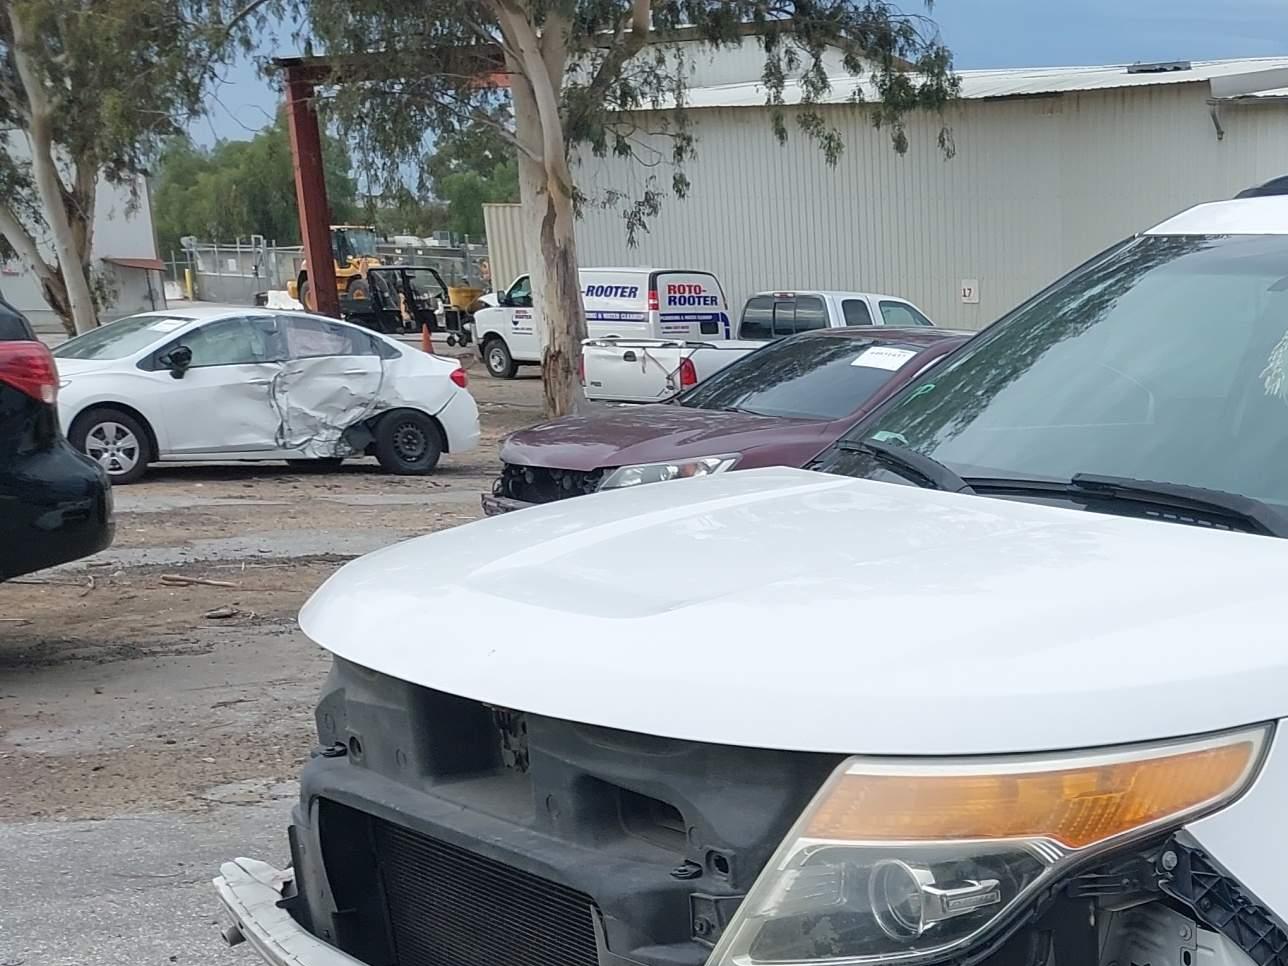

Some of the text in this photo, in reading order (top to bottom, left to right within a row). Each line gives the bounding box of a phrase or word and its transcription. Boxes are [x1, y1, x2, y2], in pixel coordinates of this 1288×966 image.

[667, 284, 706, 295] ROTO-
[962, 287, 972, 298] 17
[667, 295, 718, 306] ROOTER
